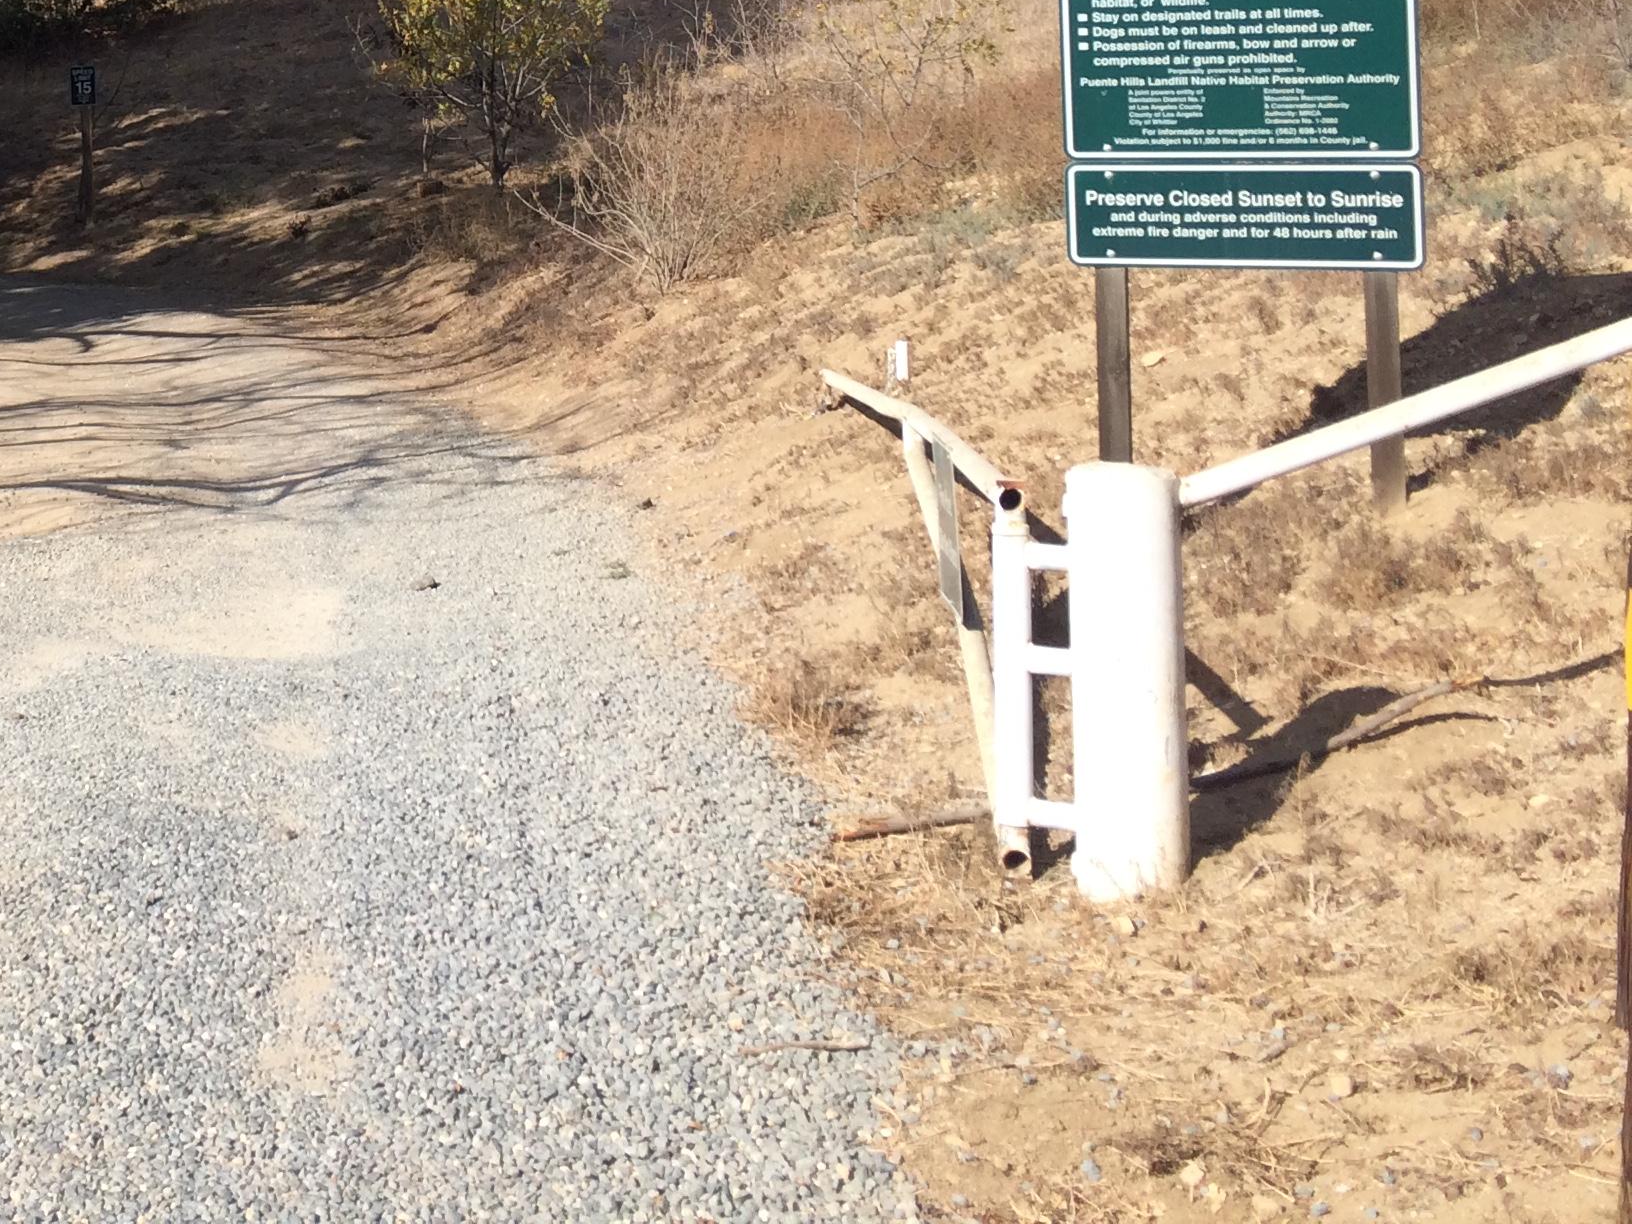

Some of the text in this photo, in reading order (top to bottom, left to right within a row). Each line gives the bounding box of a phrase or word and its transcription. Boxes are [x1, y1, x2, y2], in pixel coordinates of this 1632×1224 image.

[1092, 8, 1323, 23] Stay on designated trails at all times.
[1093, 21, 1374, 38] Dogs must be on leash and cleaned up after.
[1093, 38, 1356, 51] Possession of firearms, bow and arrow or
[1093, 53, 1297, 67] compressed air guns prohibited.
[1121, 77, 1145, 86] Hills
[1191, 77, 1226, 85] Native
[1229, 76, 1269, 84] Habitat
[1272, 75, 1344, 84] Preservation
[1347, 74, 1399, 85] Authority
[76, 82, 91, 94] 15
[1085, 189, 1404, 208] Preserve Closed Sunset to Sunrise
[1111, 211, 1377, 226] and during adverse conditions including
[1092, 226, 1398, 240] extreme fire danger and for 48 hours after rain
